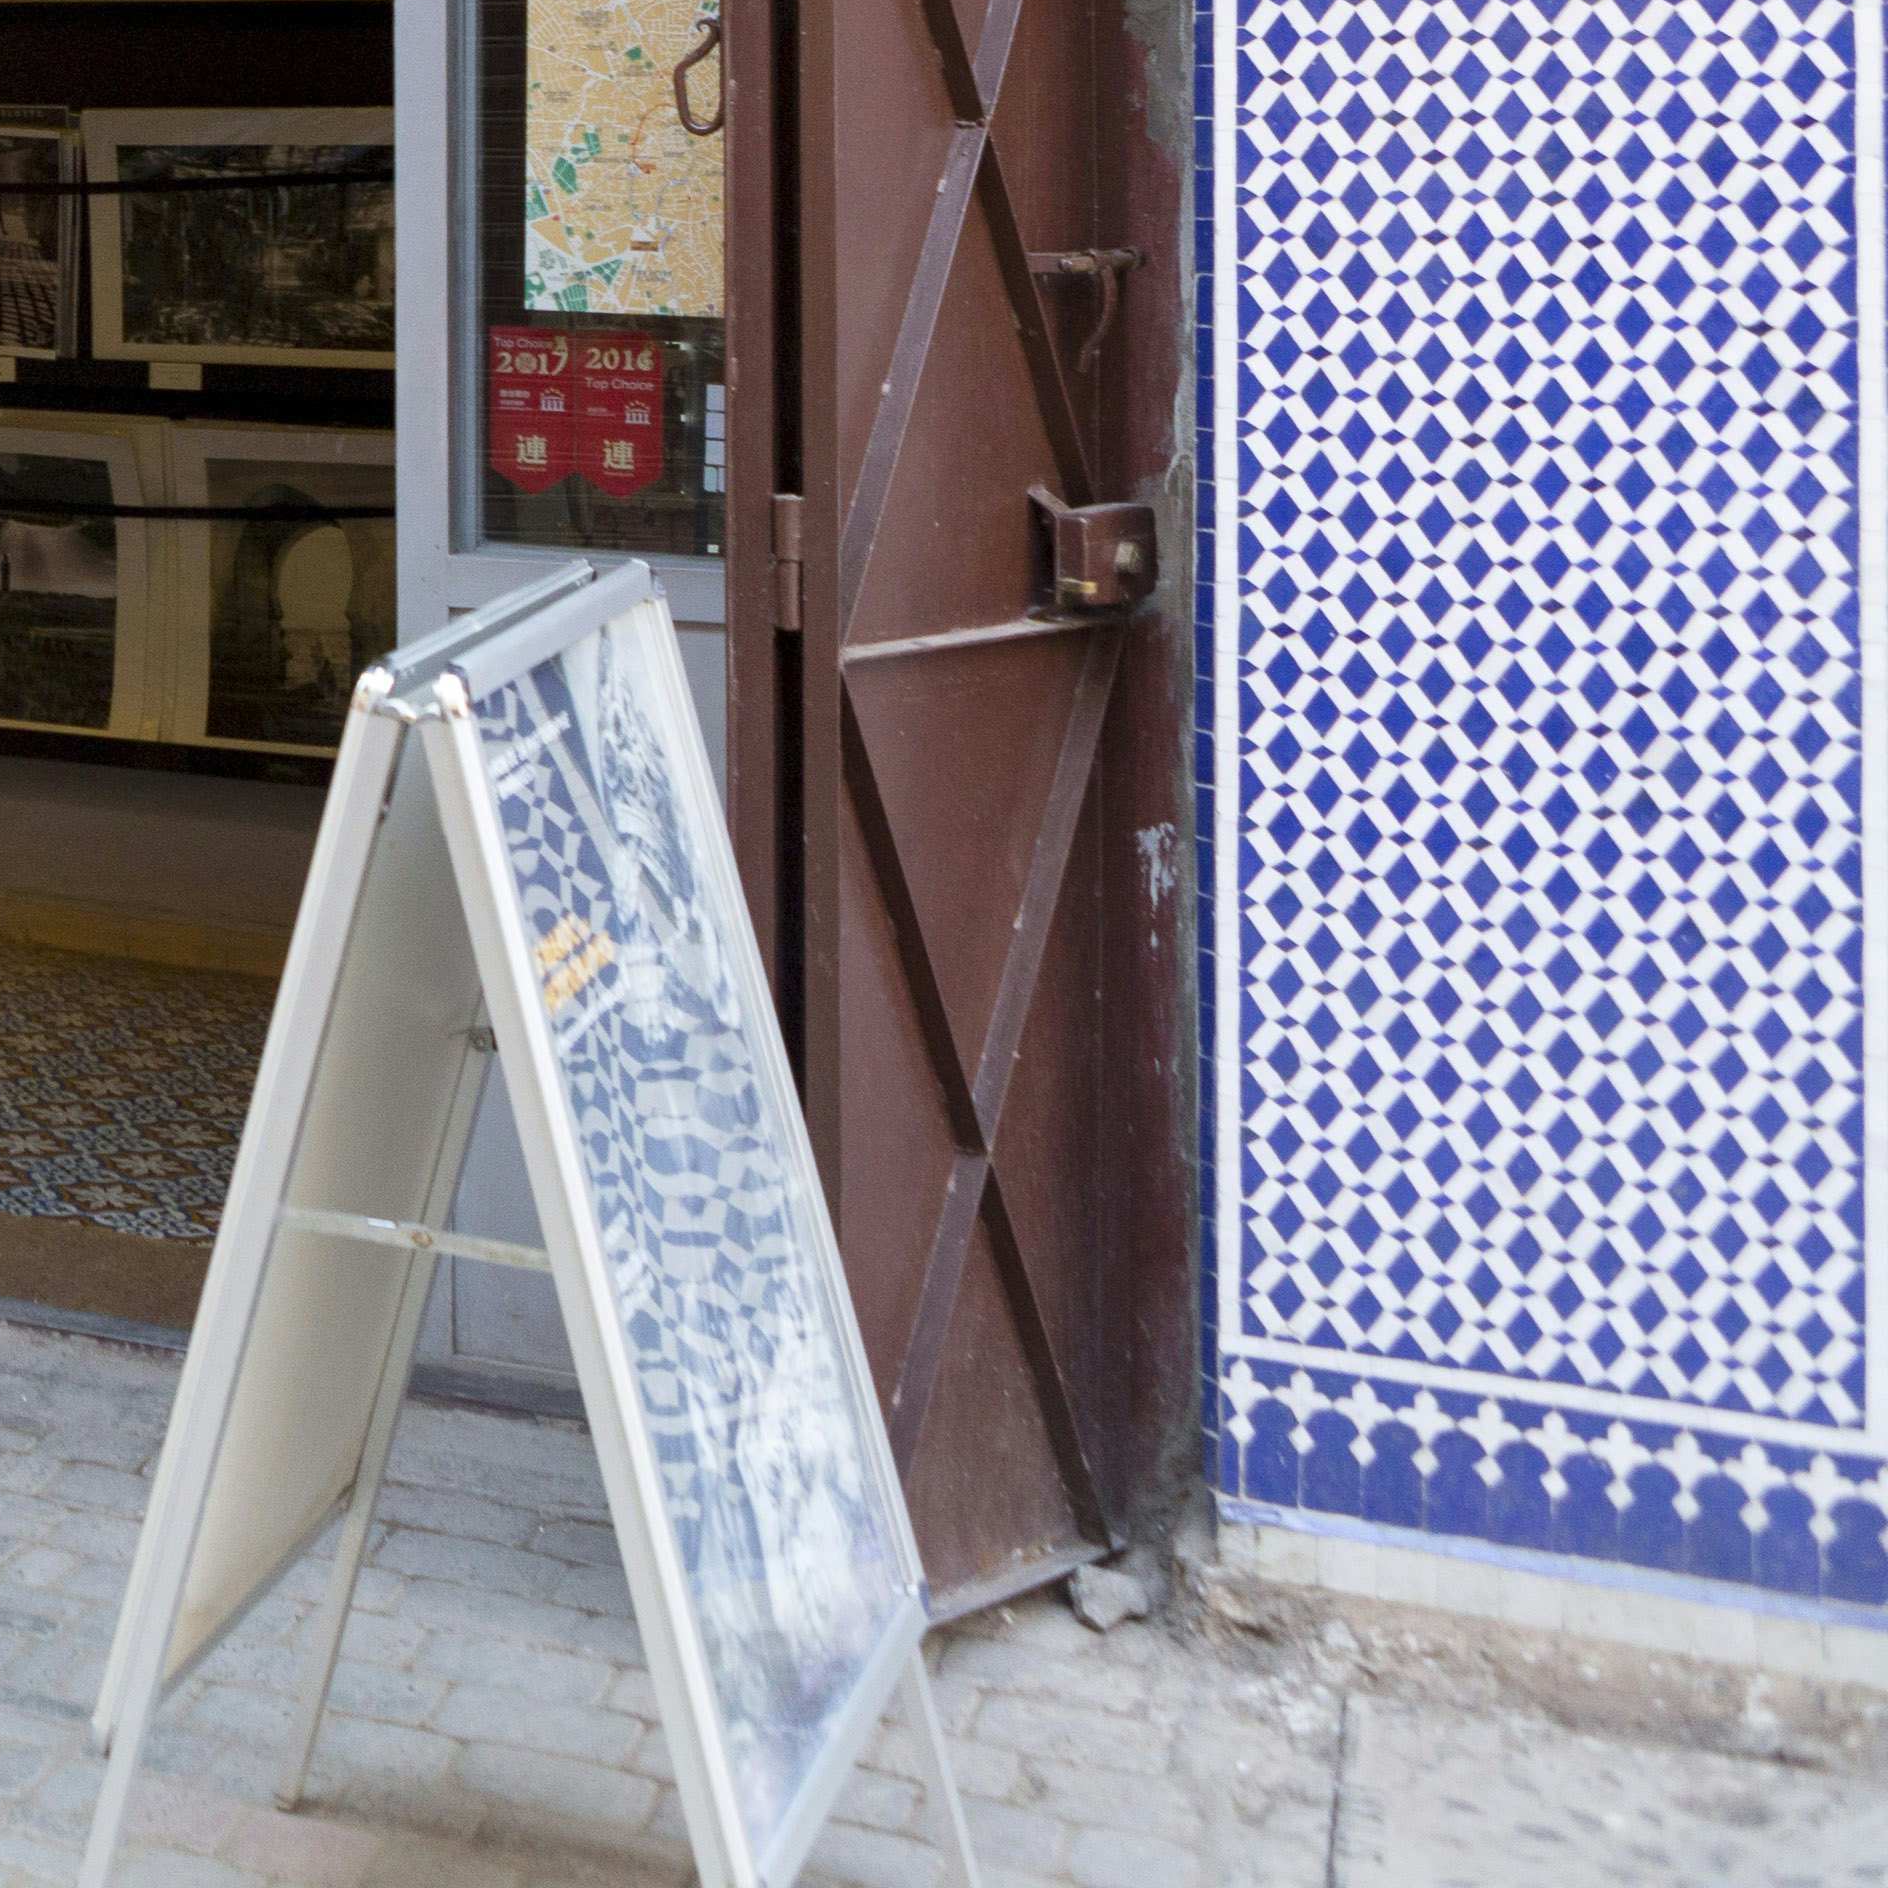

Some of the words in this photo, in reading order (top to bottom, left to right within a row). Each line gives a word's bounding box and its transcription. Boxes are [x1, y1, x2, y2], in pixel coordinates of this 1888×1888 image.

[495, 350, 569, 376] 2017
[585, 346, 655, 372] 2016
[585, 377, 609, 391] Top
[611, 378, 655, 391] Choice
